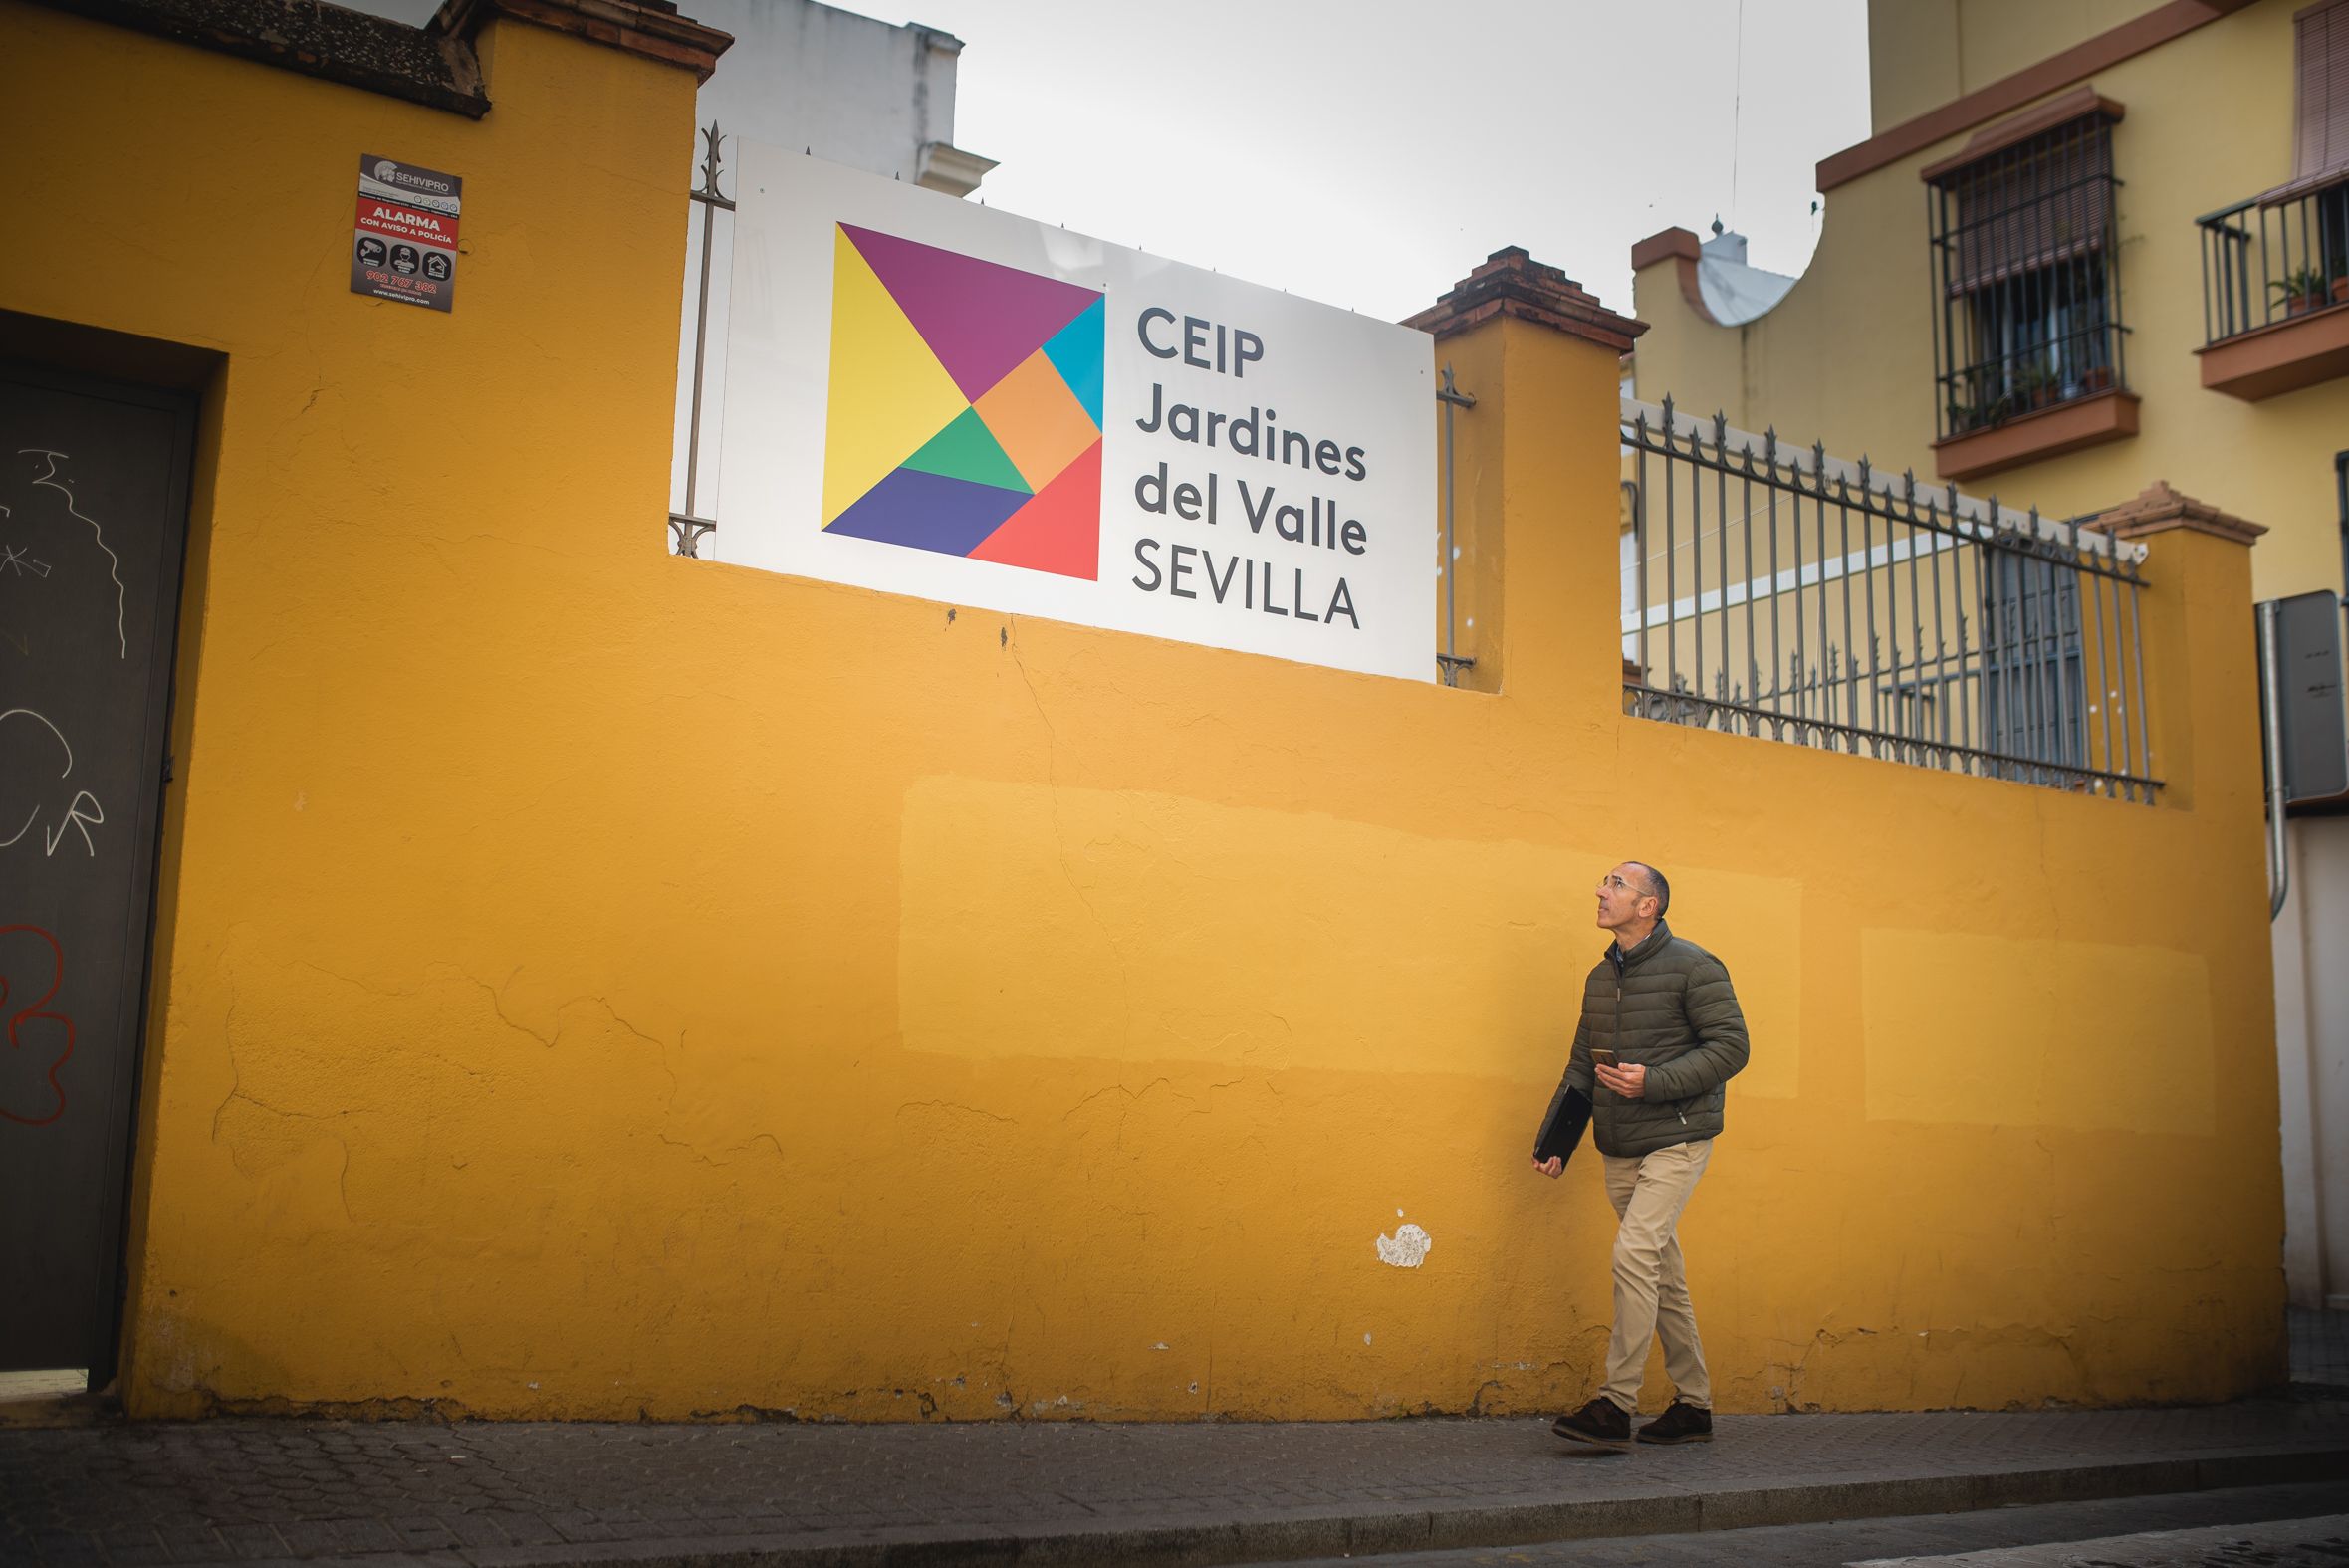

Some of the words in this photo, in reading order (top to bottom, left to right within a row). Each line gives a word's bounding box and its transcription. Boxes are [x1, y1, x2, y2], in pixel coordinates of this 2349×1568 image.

[396, 172, 449, 192] SEHIVIPRO
[360, 217, 379, 227] CON
[381, 222, 408, 233] AVISO
[418, 230, 452, 244] POLICÍA
[373, 207, 440, 231] ALARMA
[366, 270, 388, 284] 902
[390, 275, 413, 288] 767
[1137, 307, 1265, 378] CEIP
[1135, 382, 1366, 481] Jardines
[1134, 461, 1218, 525] del
[1237, 479, 1367, 556] Valle
[1131, 538, 1360, 630] SEVILLA
